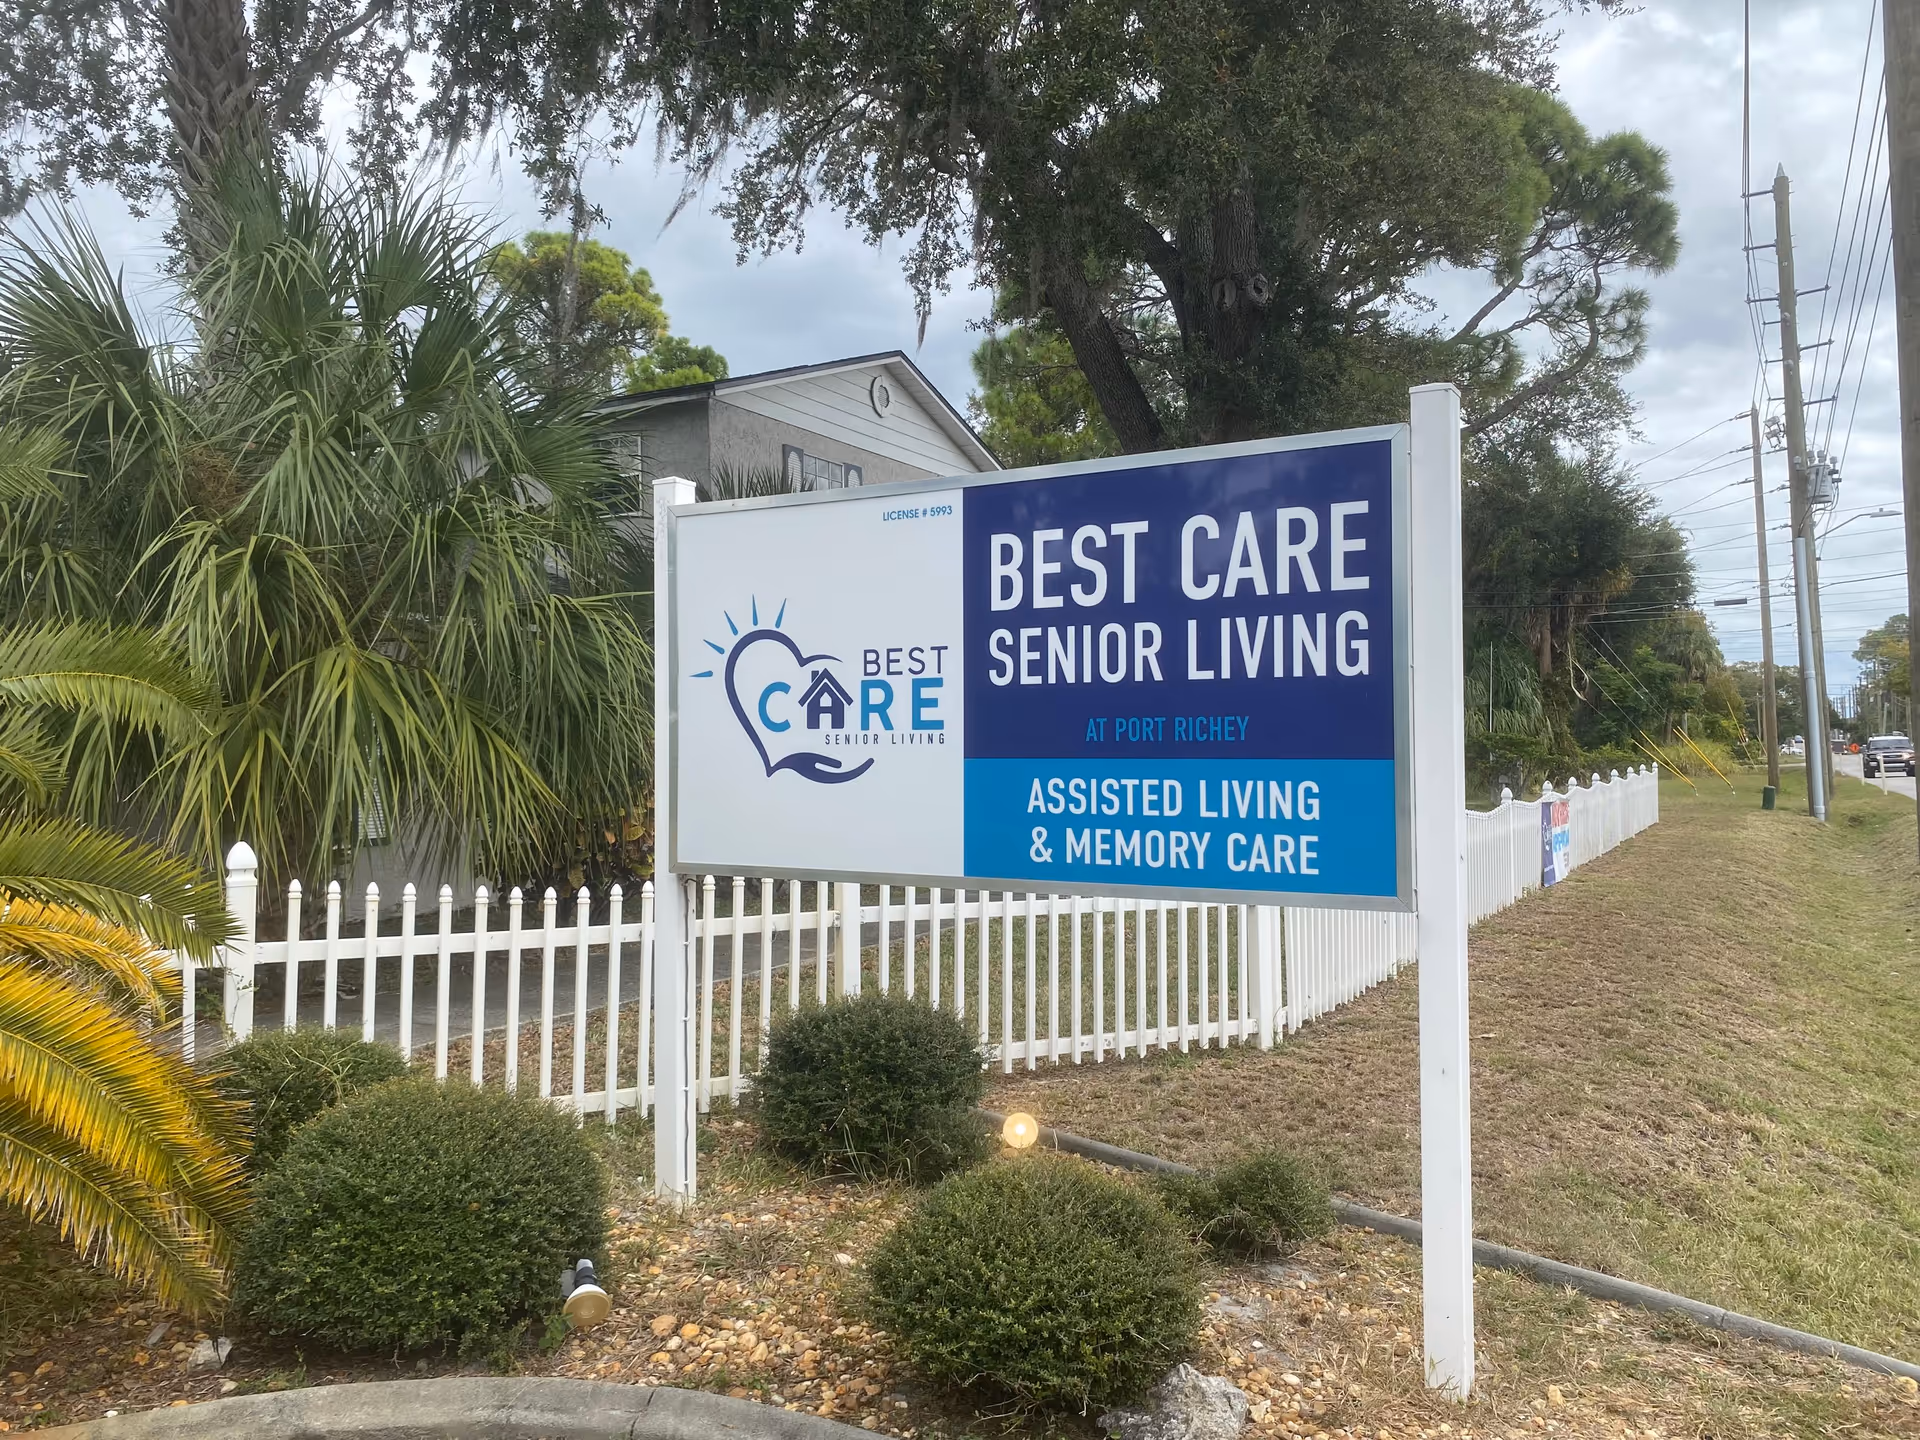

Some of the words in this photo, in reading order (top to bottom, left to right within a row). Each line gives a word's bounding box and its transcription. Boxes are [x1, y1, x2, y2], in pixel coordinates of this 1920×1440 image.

[882, 508, 920, 521] LICENSE
[922, 508, 928, 518] #
[930, 505, 953, 517] 5993
[990, 521, 1149, 611] BEST
[1181, 500, 1370, 600] CARE
[863, 645, 948, 676] BEST
[988, 622, 1164, 686] SENIOR
[1187, 610, 1370, 681] LIVING
[758, 668, 944, 732] CARE
[825, 733, 880, 745] SENIOR
[891, 733, 946, 745] LIVING
[1085, 718, 1107, 742] AT
[1115, 717, 1166, 742] PORT
[1174, 716, 1250, 742] RICHEY
[1027, 778, 1182, 817] ASSISTED
[1199, 780, 1321, 821] LIVING
[1029, 826, 1053, 863] &
[1066, 827, 1211, 870] MEMORY
[1227, 832, 1320, 876] CARE
